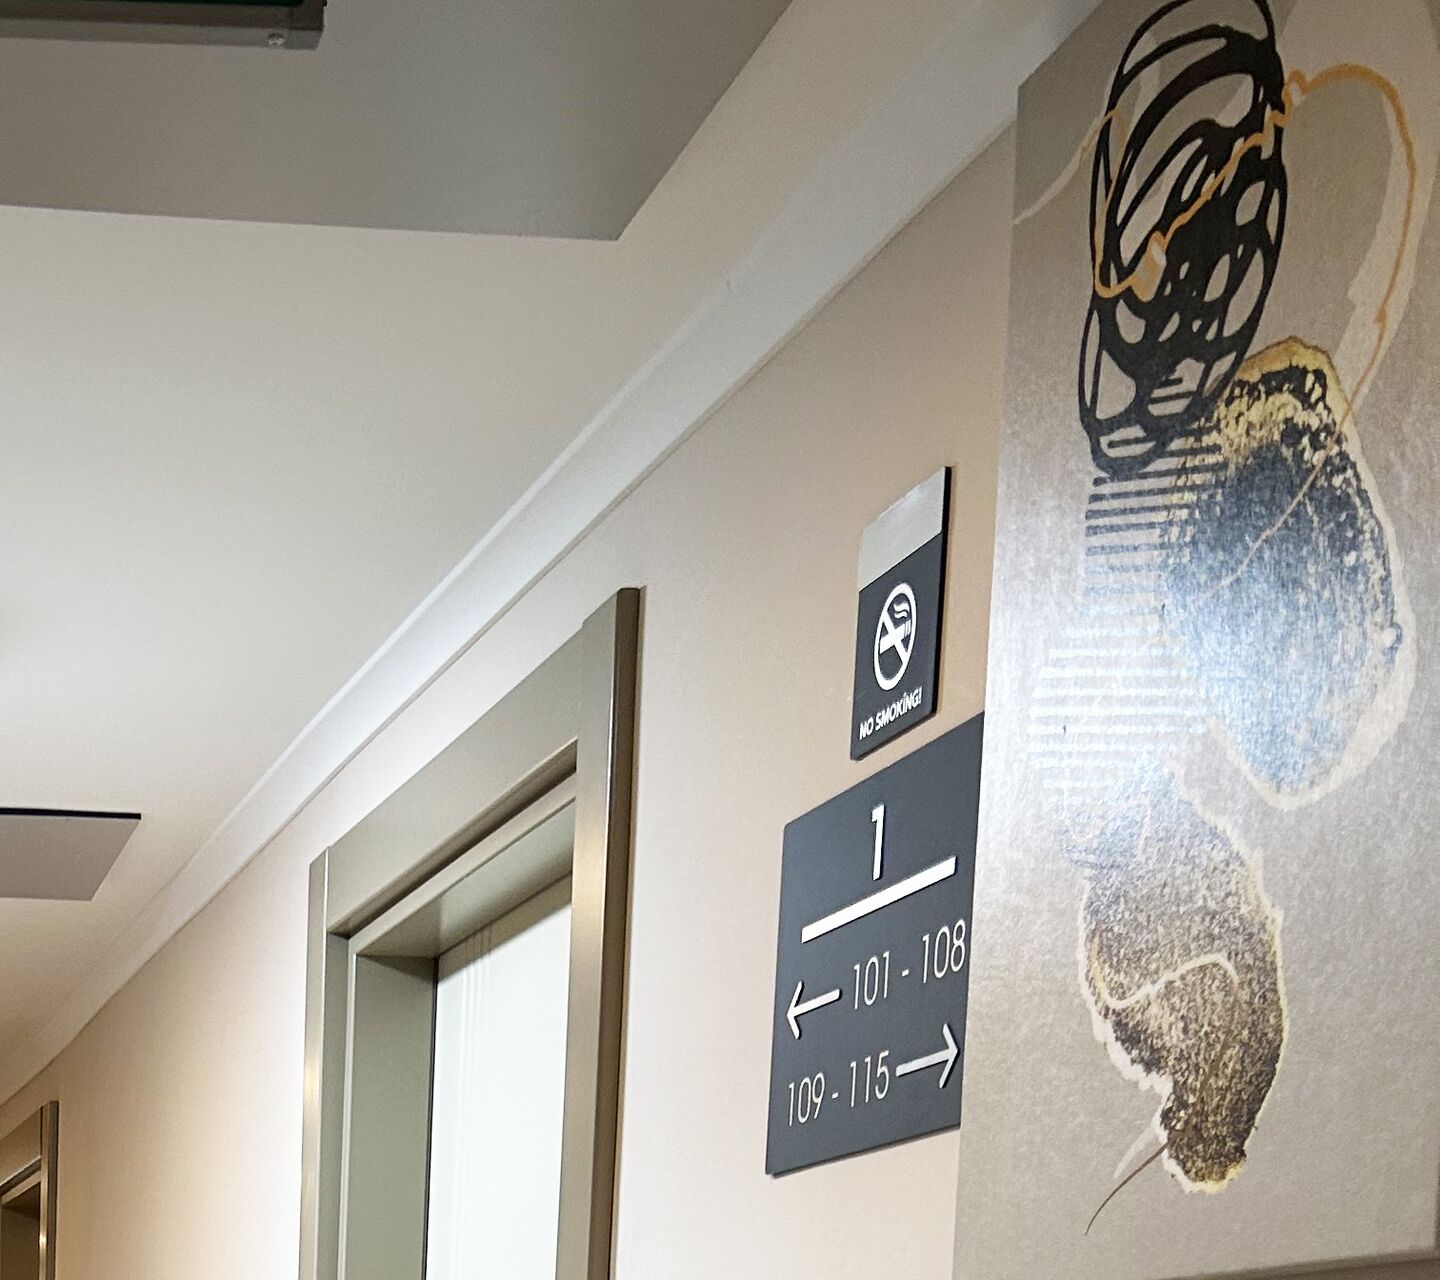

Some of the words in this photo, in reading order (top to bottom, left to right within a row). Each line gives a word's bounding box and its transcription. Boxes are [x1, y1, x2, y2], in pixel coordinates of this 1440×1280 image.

[859, 716, 875, 741] NO
[871, 804, 885, 881] 1
[854, 951, 890, 1010] 101
[922, 918, 966, 984] 108
[788, 1072, 825, 1127] 109
[850, 1049, 890, 1108] 115
